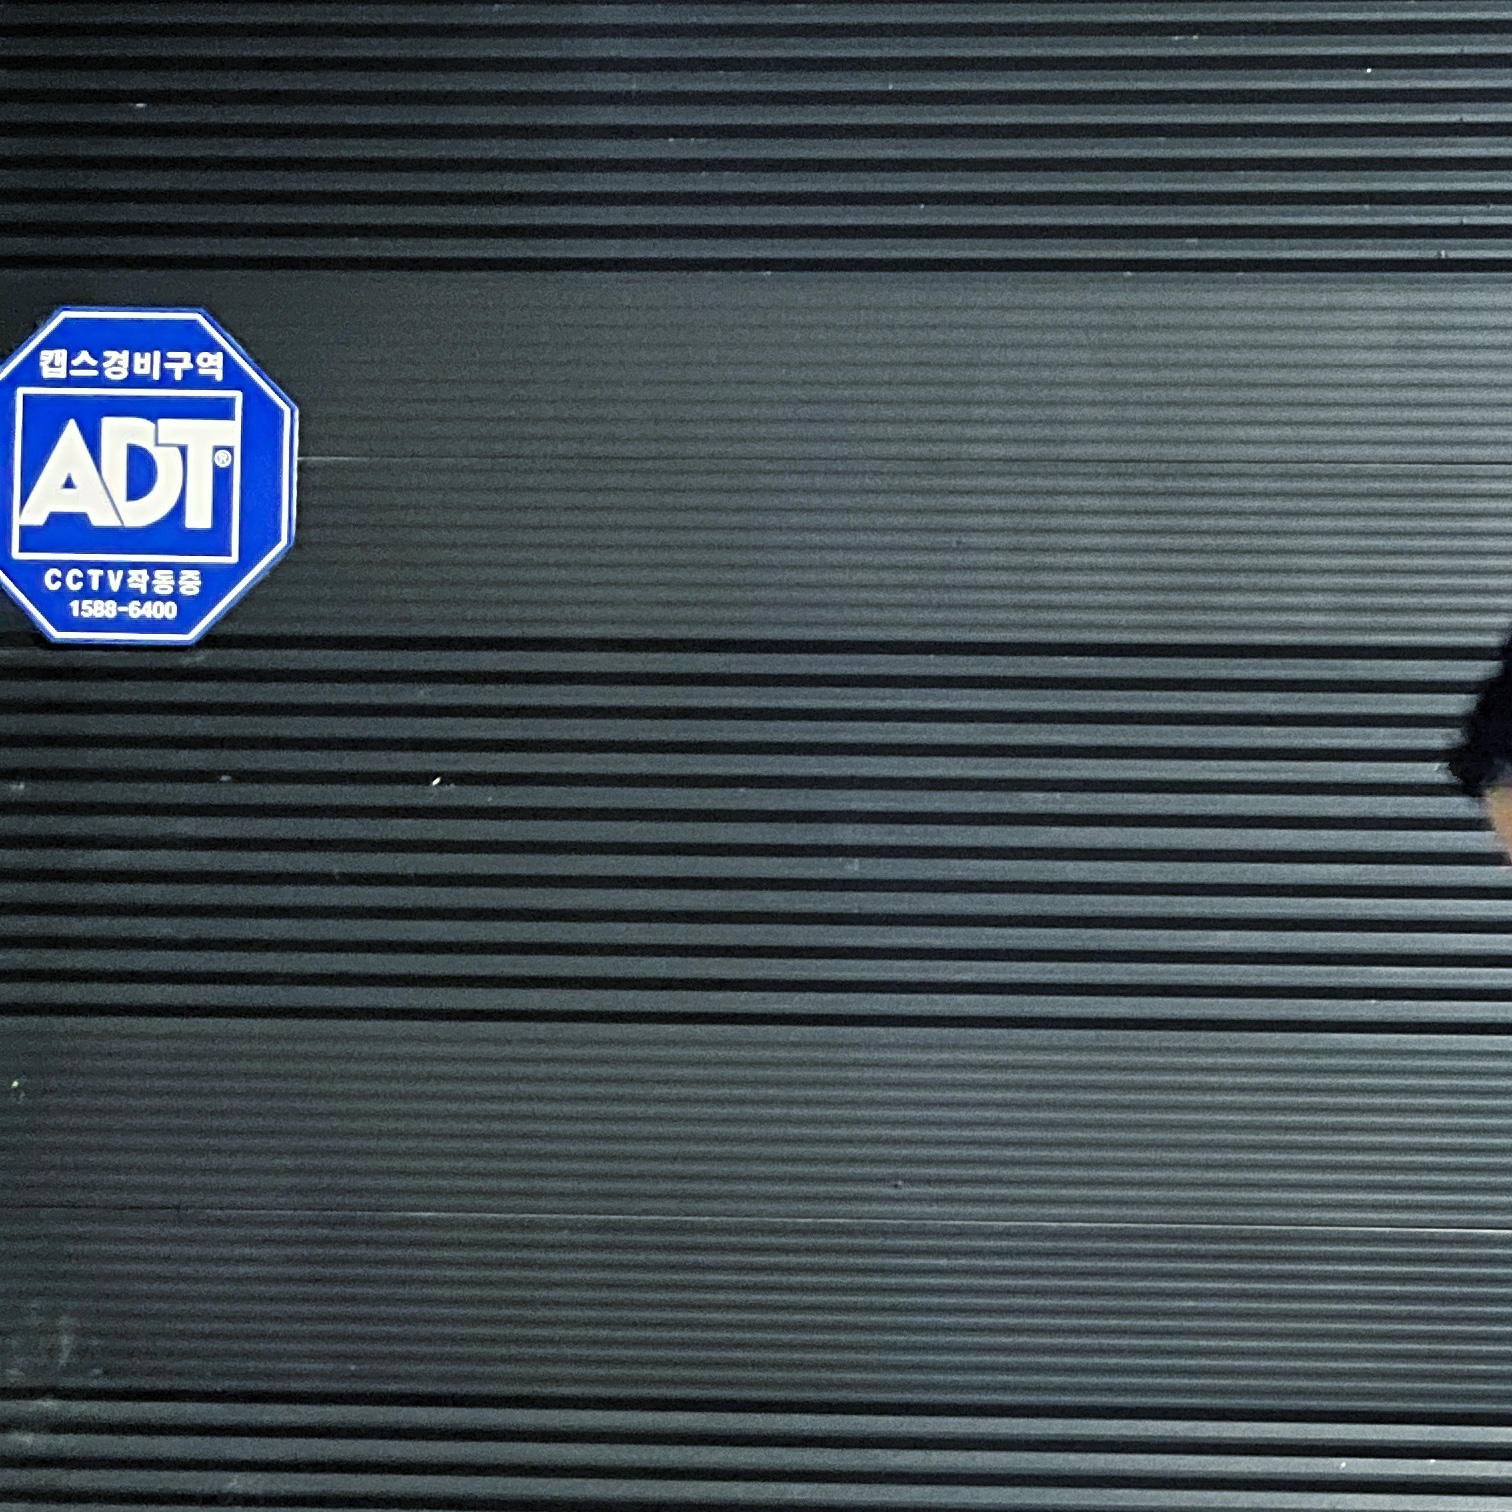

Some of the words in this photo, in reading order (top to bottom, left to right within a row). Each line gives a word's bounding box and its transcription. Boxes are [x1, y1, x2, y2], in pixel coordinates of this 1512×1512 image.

[39, 348, 224, 382] 캡스경비구역
[44, 567, 202, 596] CCTV작동중
[69, 599, 178, 620] 1588-6400
